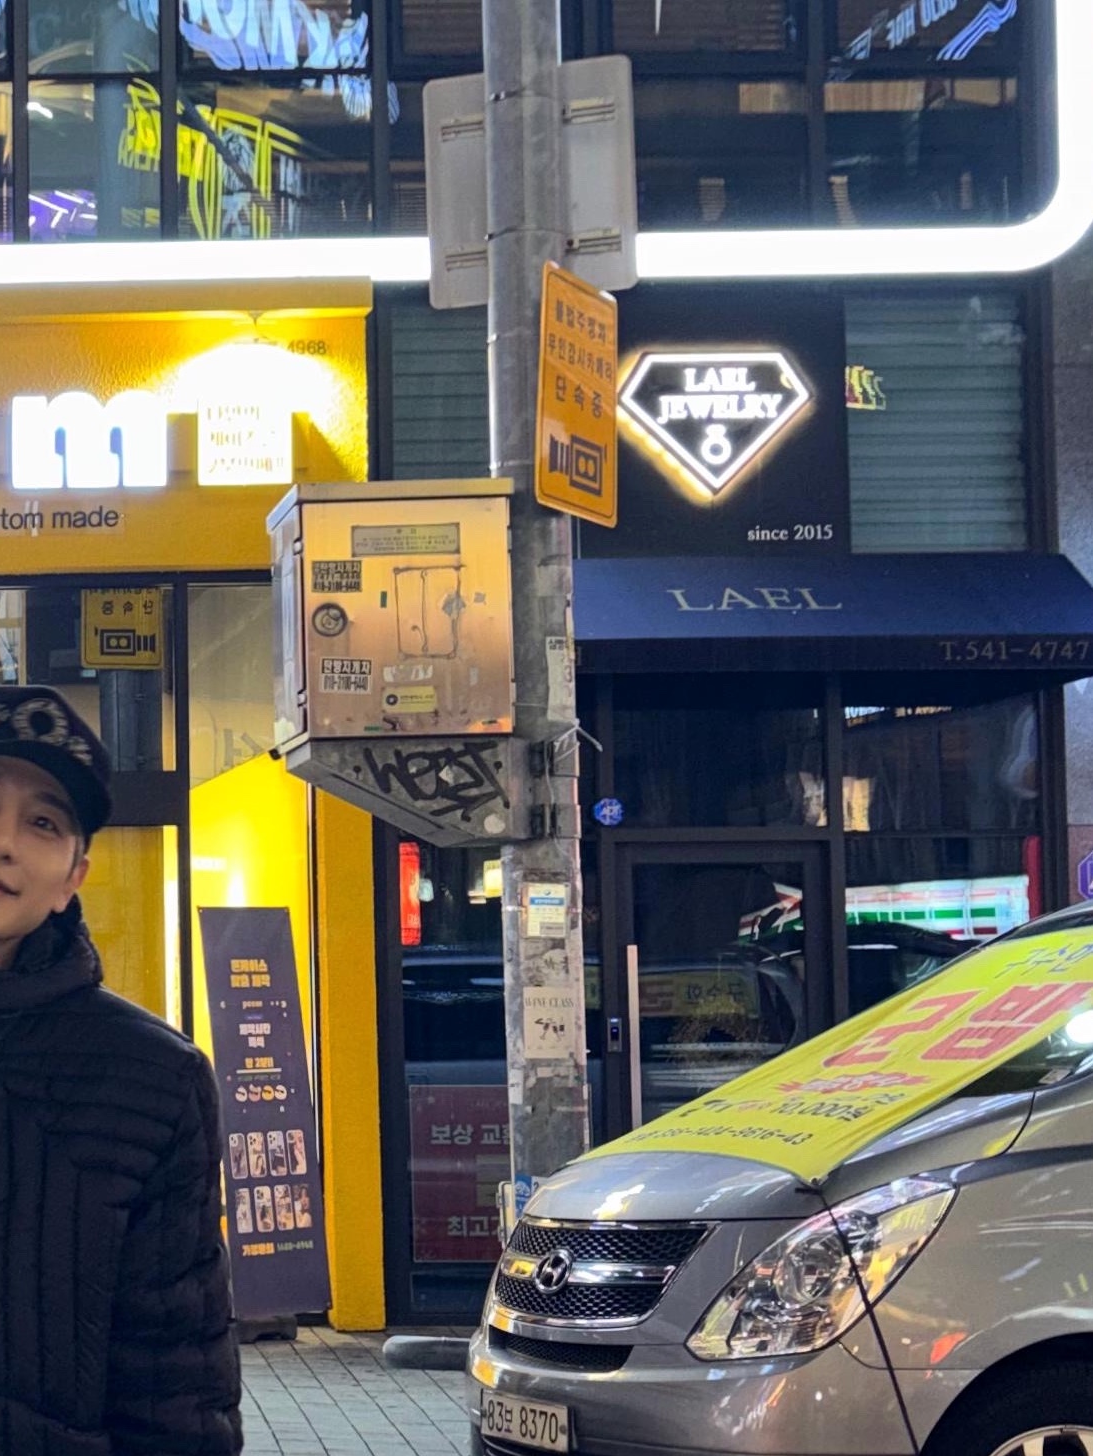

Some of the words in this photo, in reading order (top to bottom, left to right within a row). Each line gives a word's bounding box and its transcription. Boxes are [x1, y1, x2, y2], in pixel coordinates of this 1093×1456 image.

[683, 367, 756, 392] LAEL
[657, 394, 783, 424] JEWELRY
[51, 506, 119, 528] made
[747, 526, 789, 541] since
[794, 524, 834, 541] 2015
[666, 587, 843, 611] LAEL
[939, 640, 1090, 661] T.541-4747
[430, 1124, 475, 1146] 보상
[519, 1406, 559, 1444] 8370
